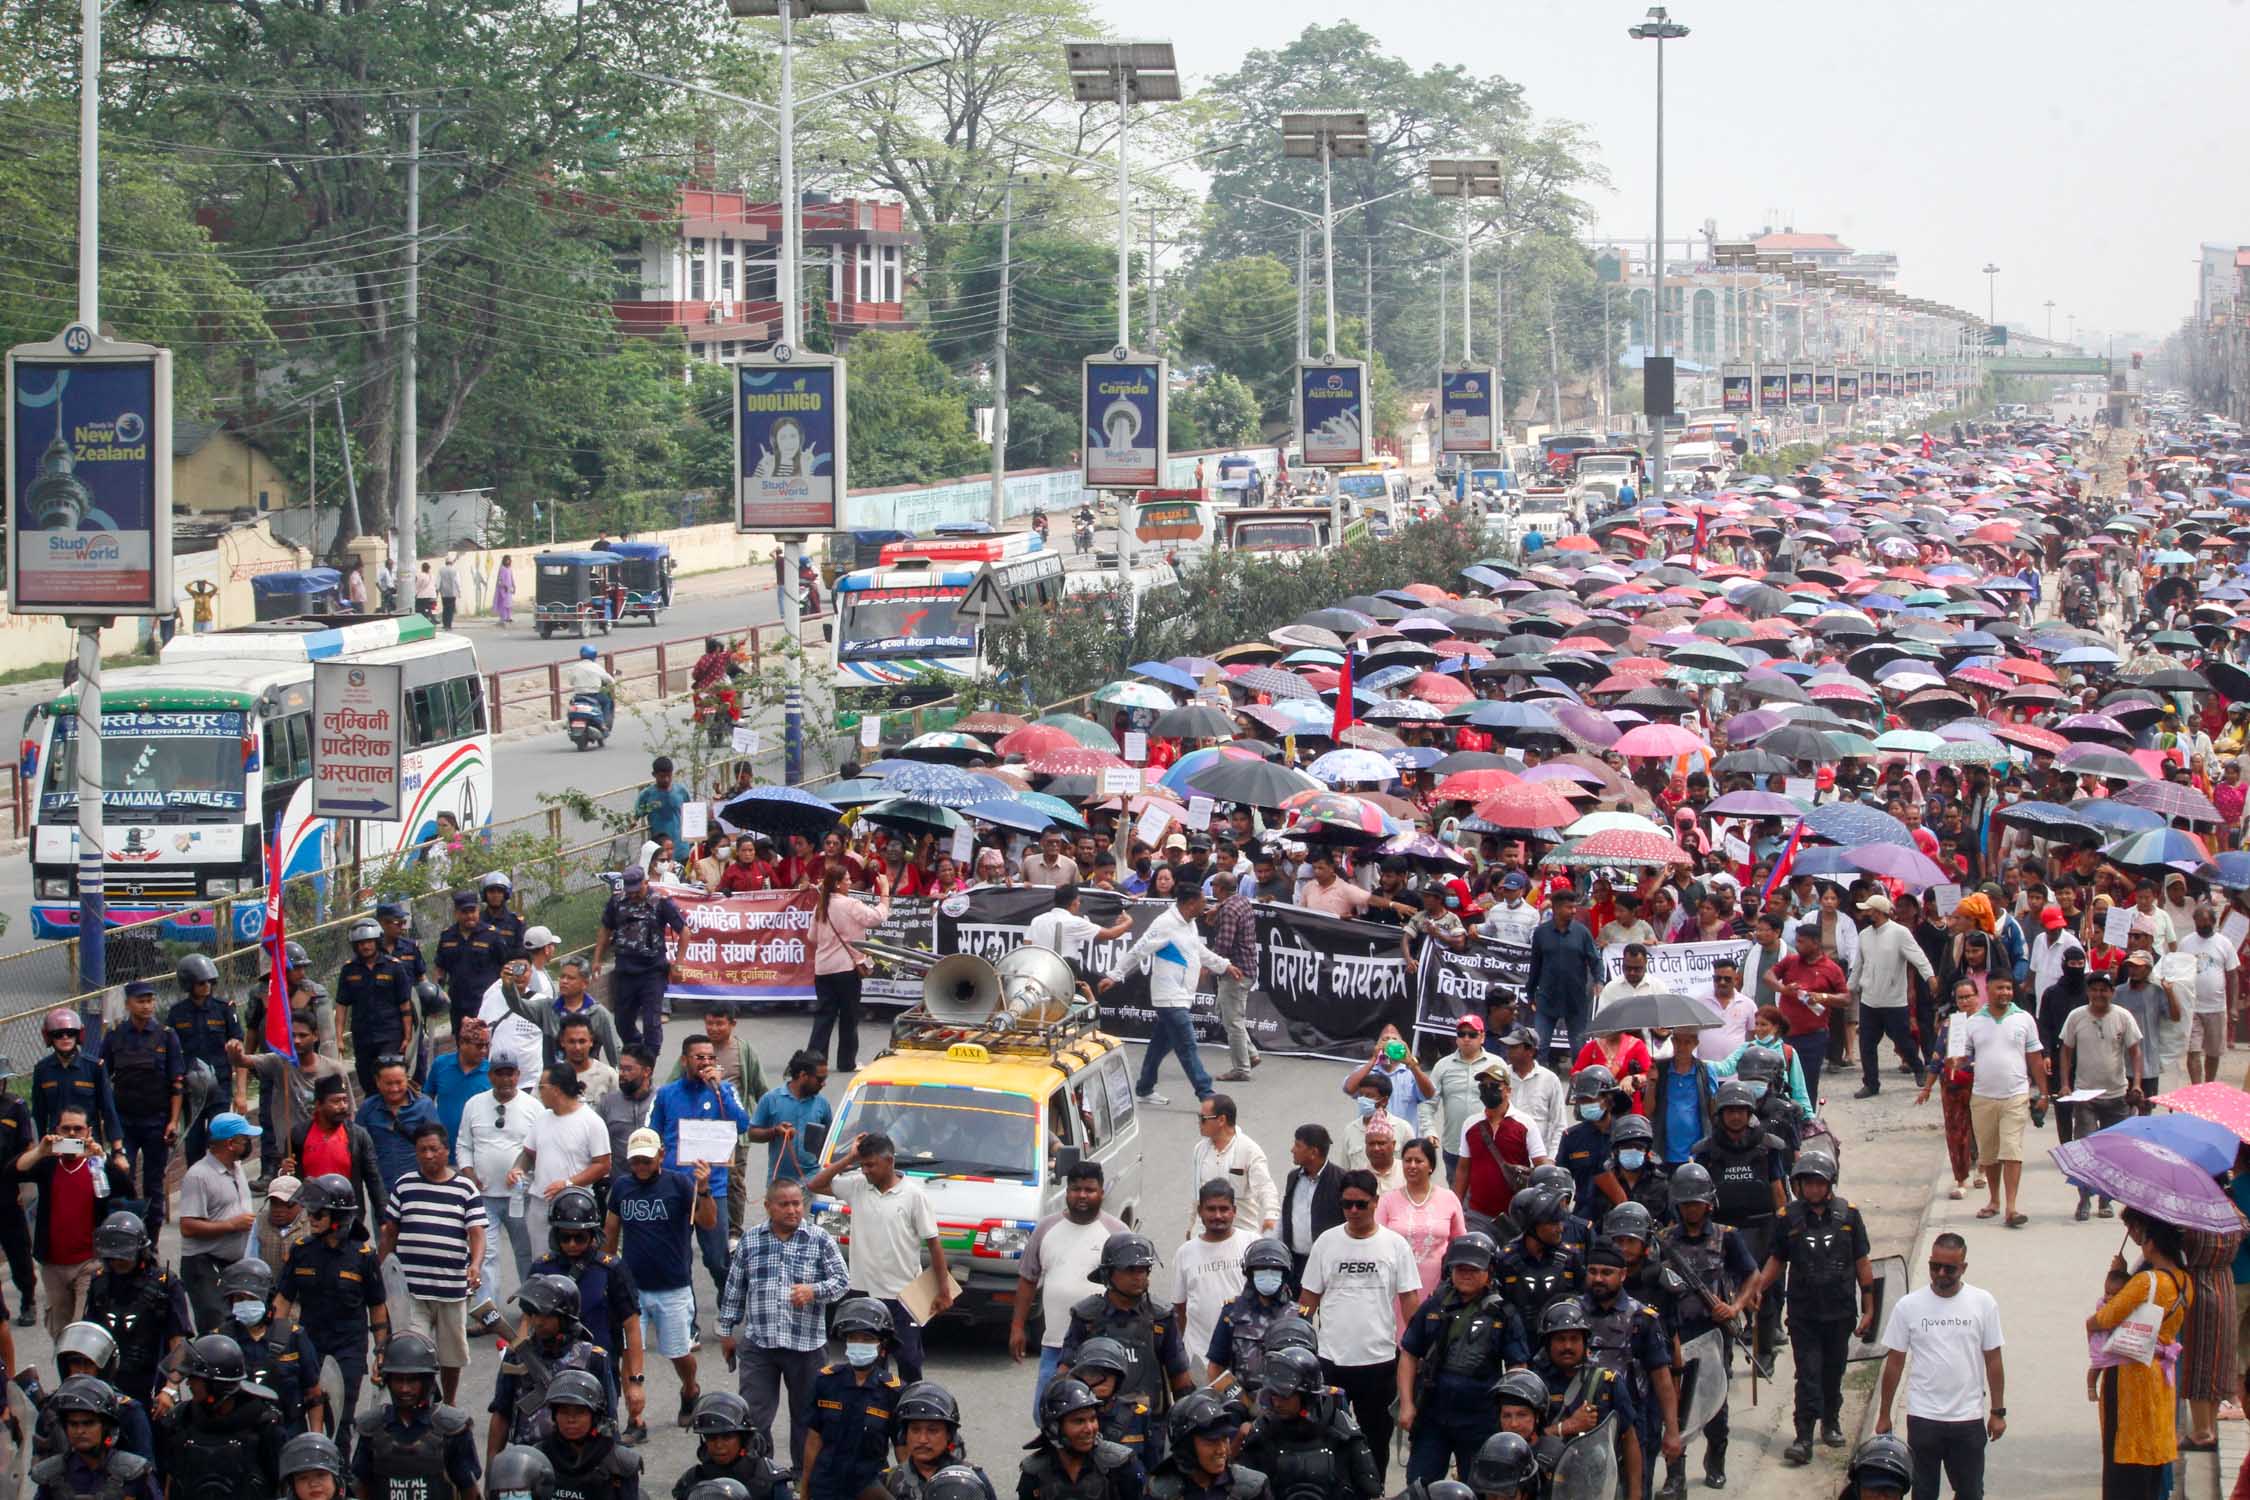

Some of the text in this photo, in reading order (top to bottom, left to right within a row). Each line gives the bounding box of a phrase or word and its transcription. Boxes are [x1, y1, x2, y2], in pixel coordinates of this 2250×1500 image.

[67, 329, 89, 350] 49
[775, 346, 792, 361] 48
[1099, 382, 1149, 395] Canada
[747, 392, 822, 413] DUOLINGO
[75, 427, 114, 443] New
[75, 444, 147, 461] Zealand
[49, 536, 88, 551] Study
[75, 544, 119, 561] World
[323, 707, 390, 733] लुम्बिनी
[320, 734, 392, 757] प्रादेशिक
[318, 764, 394, 783] अस्पताल
[166, 792, 223, 805] TRAVELS
[720, 940, 757, 964] संघर्ष
[760, 938, 806, 964] समिति
[1268, 927, 1325, 1002] विरोध
[1332, 942, 1408, 1000] कार्यक्रम
[1660, 951, 1683, 974] टोल
[1436, 967, 1490, 1001] विरोध
[953, 1048, 981, 1058] TAXI
[1724, 1173, 1753, 1181] POLICE
[1725, 1165, 1753, 1174] NEPAL
[622, 1199, 669, 1221] USA
[1338, 1262, 1379, 1274] PESR.
[389, 1489, 427, 1500] POLCE
